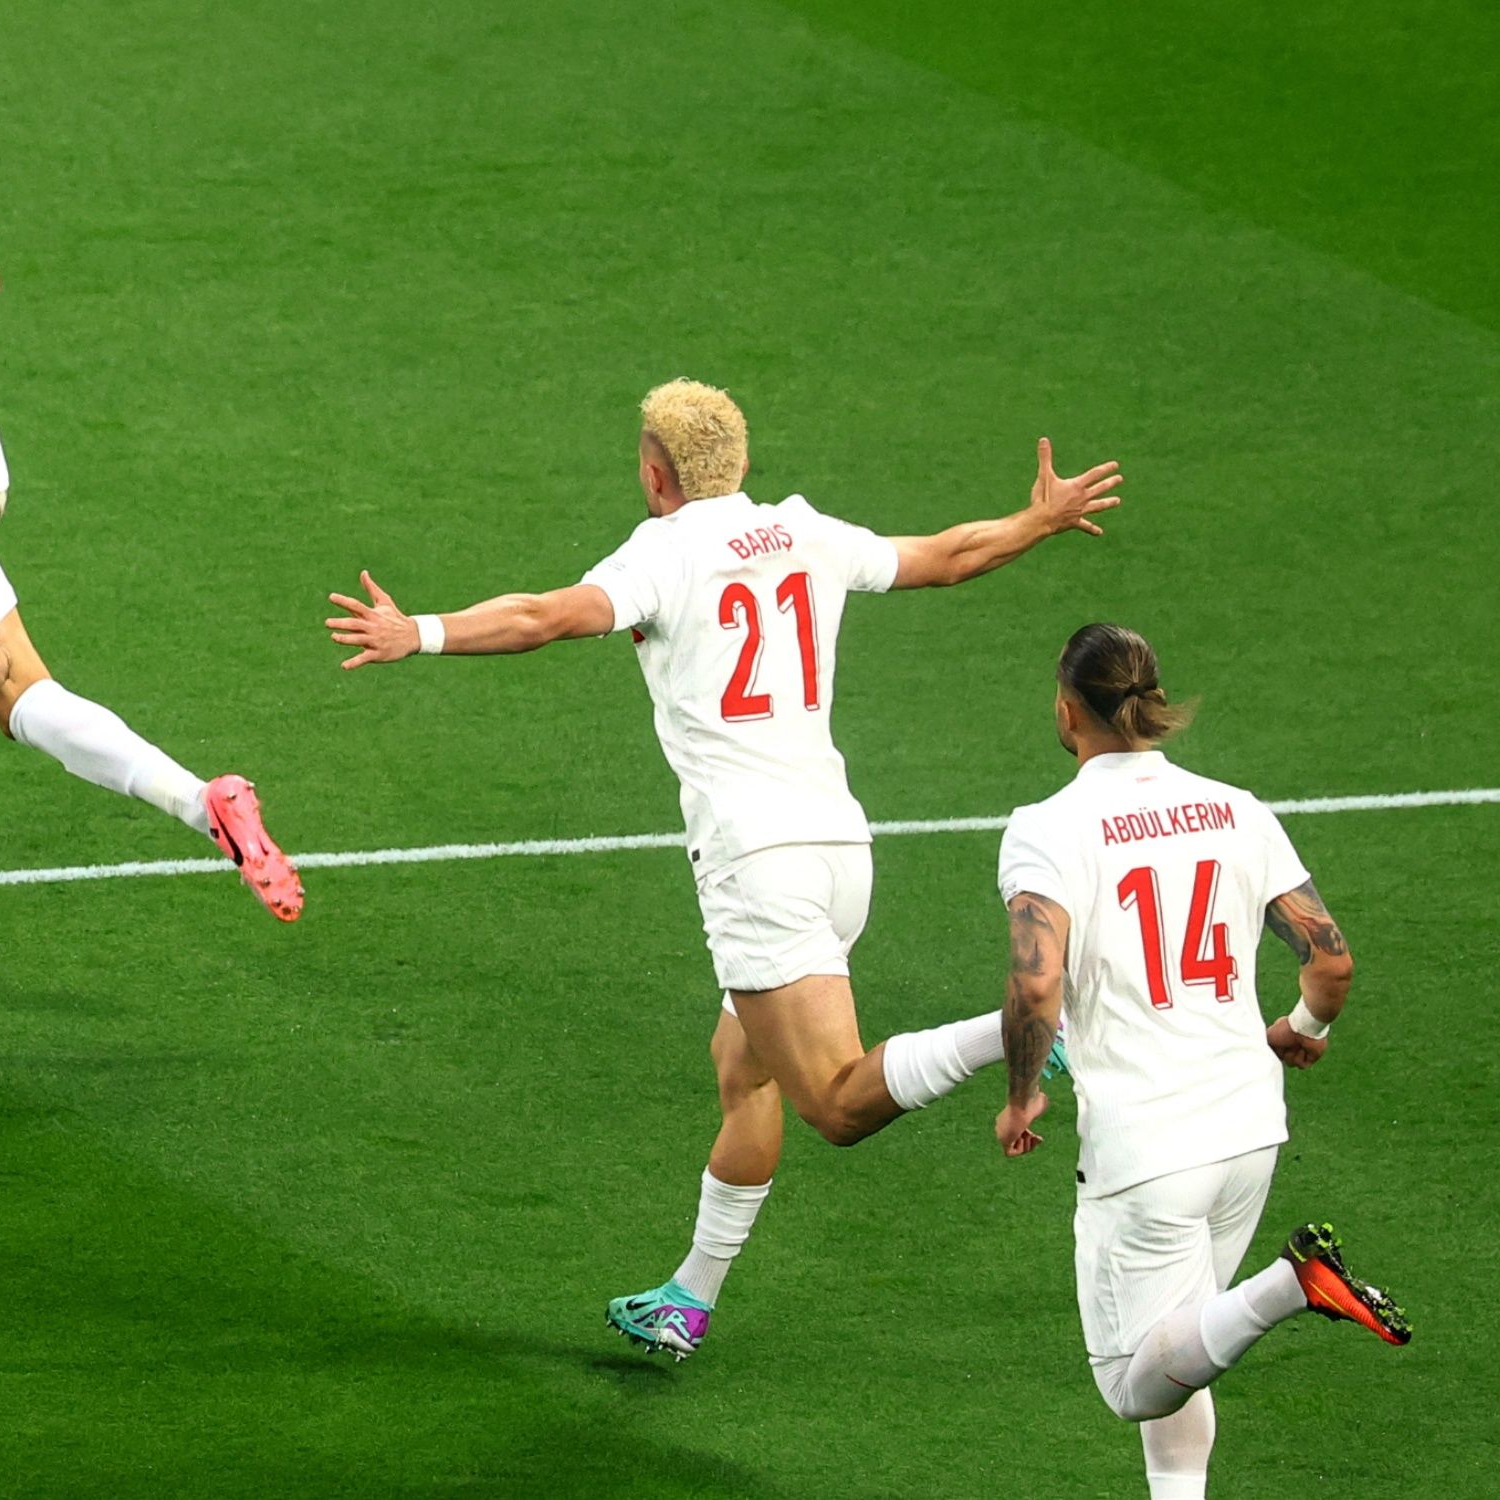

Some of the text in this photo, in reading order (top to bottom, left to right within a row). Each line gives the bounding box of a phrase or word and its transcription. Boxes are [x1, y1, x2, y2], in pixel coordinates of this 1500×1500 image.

[727, 524, 793, 560] BARIŞ
[719, 572, 820, 723] 21
[1101, 797, 1236, 846] ABDÜLKERİM
[1117, 859, 1238, 1010] 14
